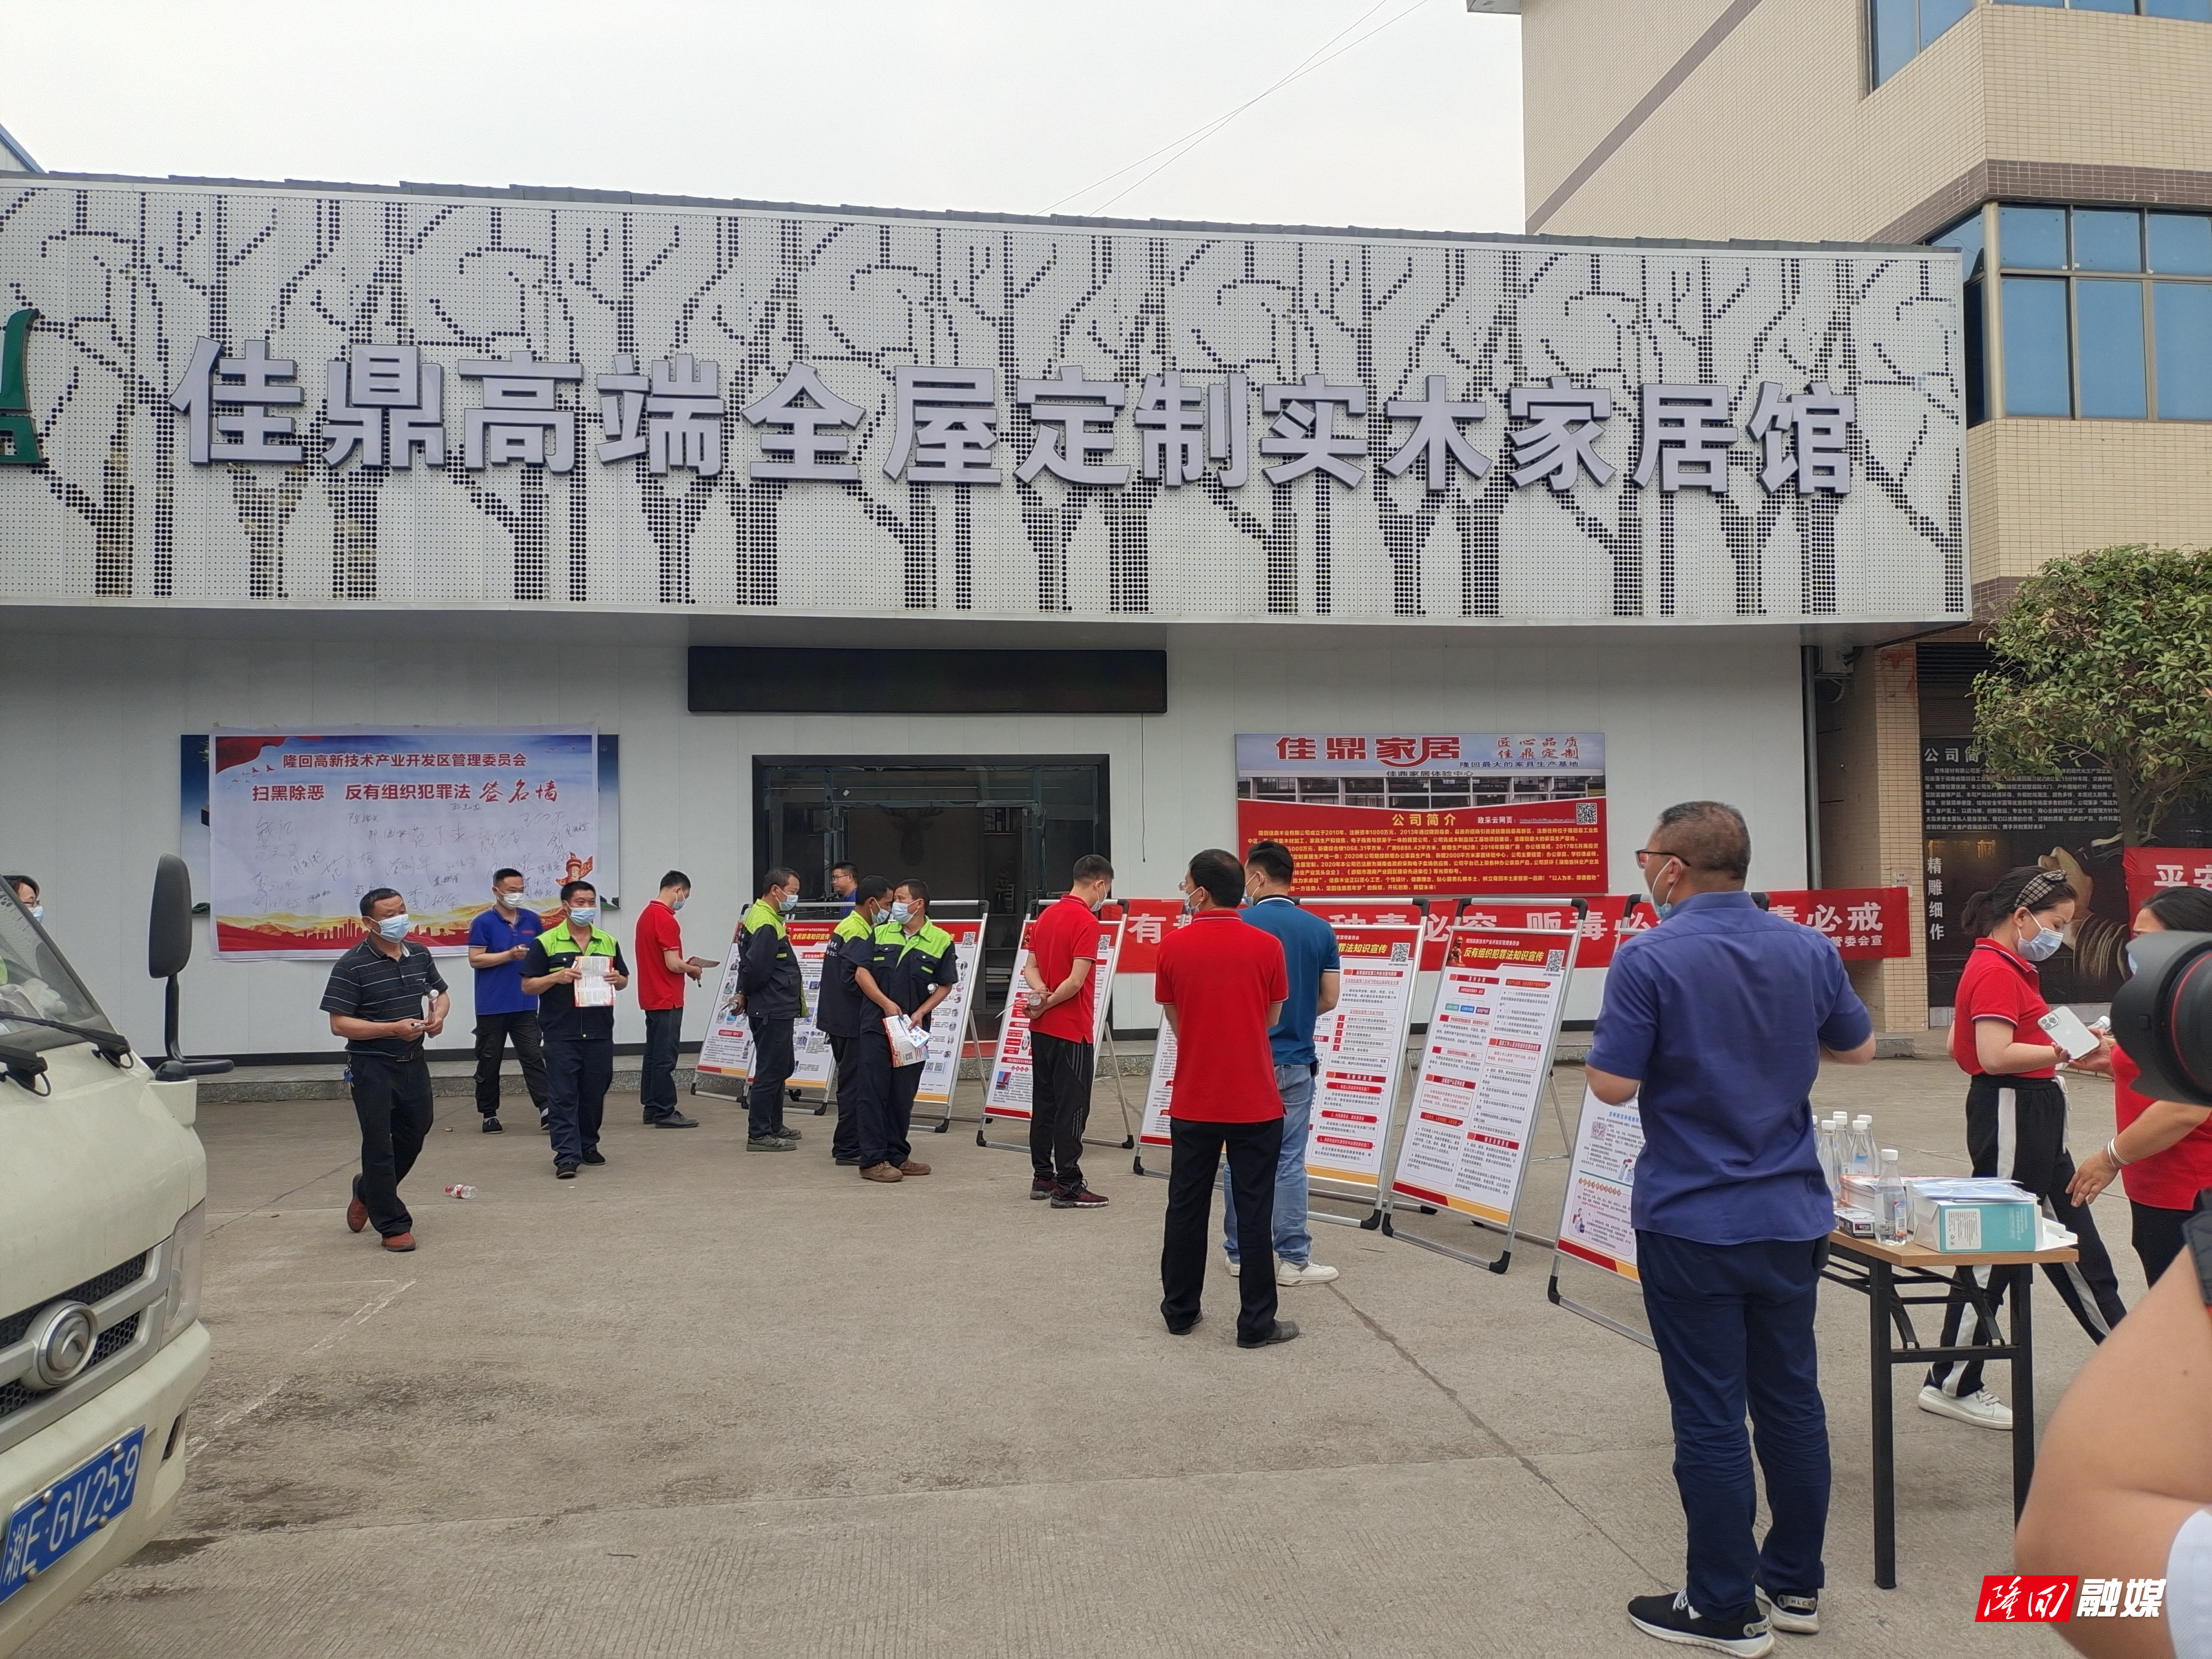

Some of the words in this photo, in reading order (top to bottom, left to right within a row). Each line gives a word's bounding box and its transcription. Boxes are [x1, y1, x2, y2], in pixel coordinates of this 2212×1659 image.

[168, 335, 1856, 495] 佳鼎高端全屋定制实木家居馆
[1497, 737, 1578, 747] 匠心品质
[1275, 736, 1461, 768] 佳鼎家居
[1497, 748, 1579, 759] 佳鼎定制
[283, 753, 527, 768] 隆回高新技术产业开发区管理委员会
[252, 784, 325, 801] 扫黑除恶
[345, 782, 472, 800] 反有组织犯罪法
[478, 778, 559, 804] 签名墙
[1392, 813, 1457, 826] 公司简介
[1927, 857, 1945, 940] 精雕细作
[1338, 943, 1388, 954] 罪法知识宣传
[1463, 947, 1545, 962] 反有组织犯罪法知识宣传
[3, 1443, 139, 1586] 湘E·GV259
